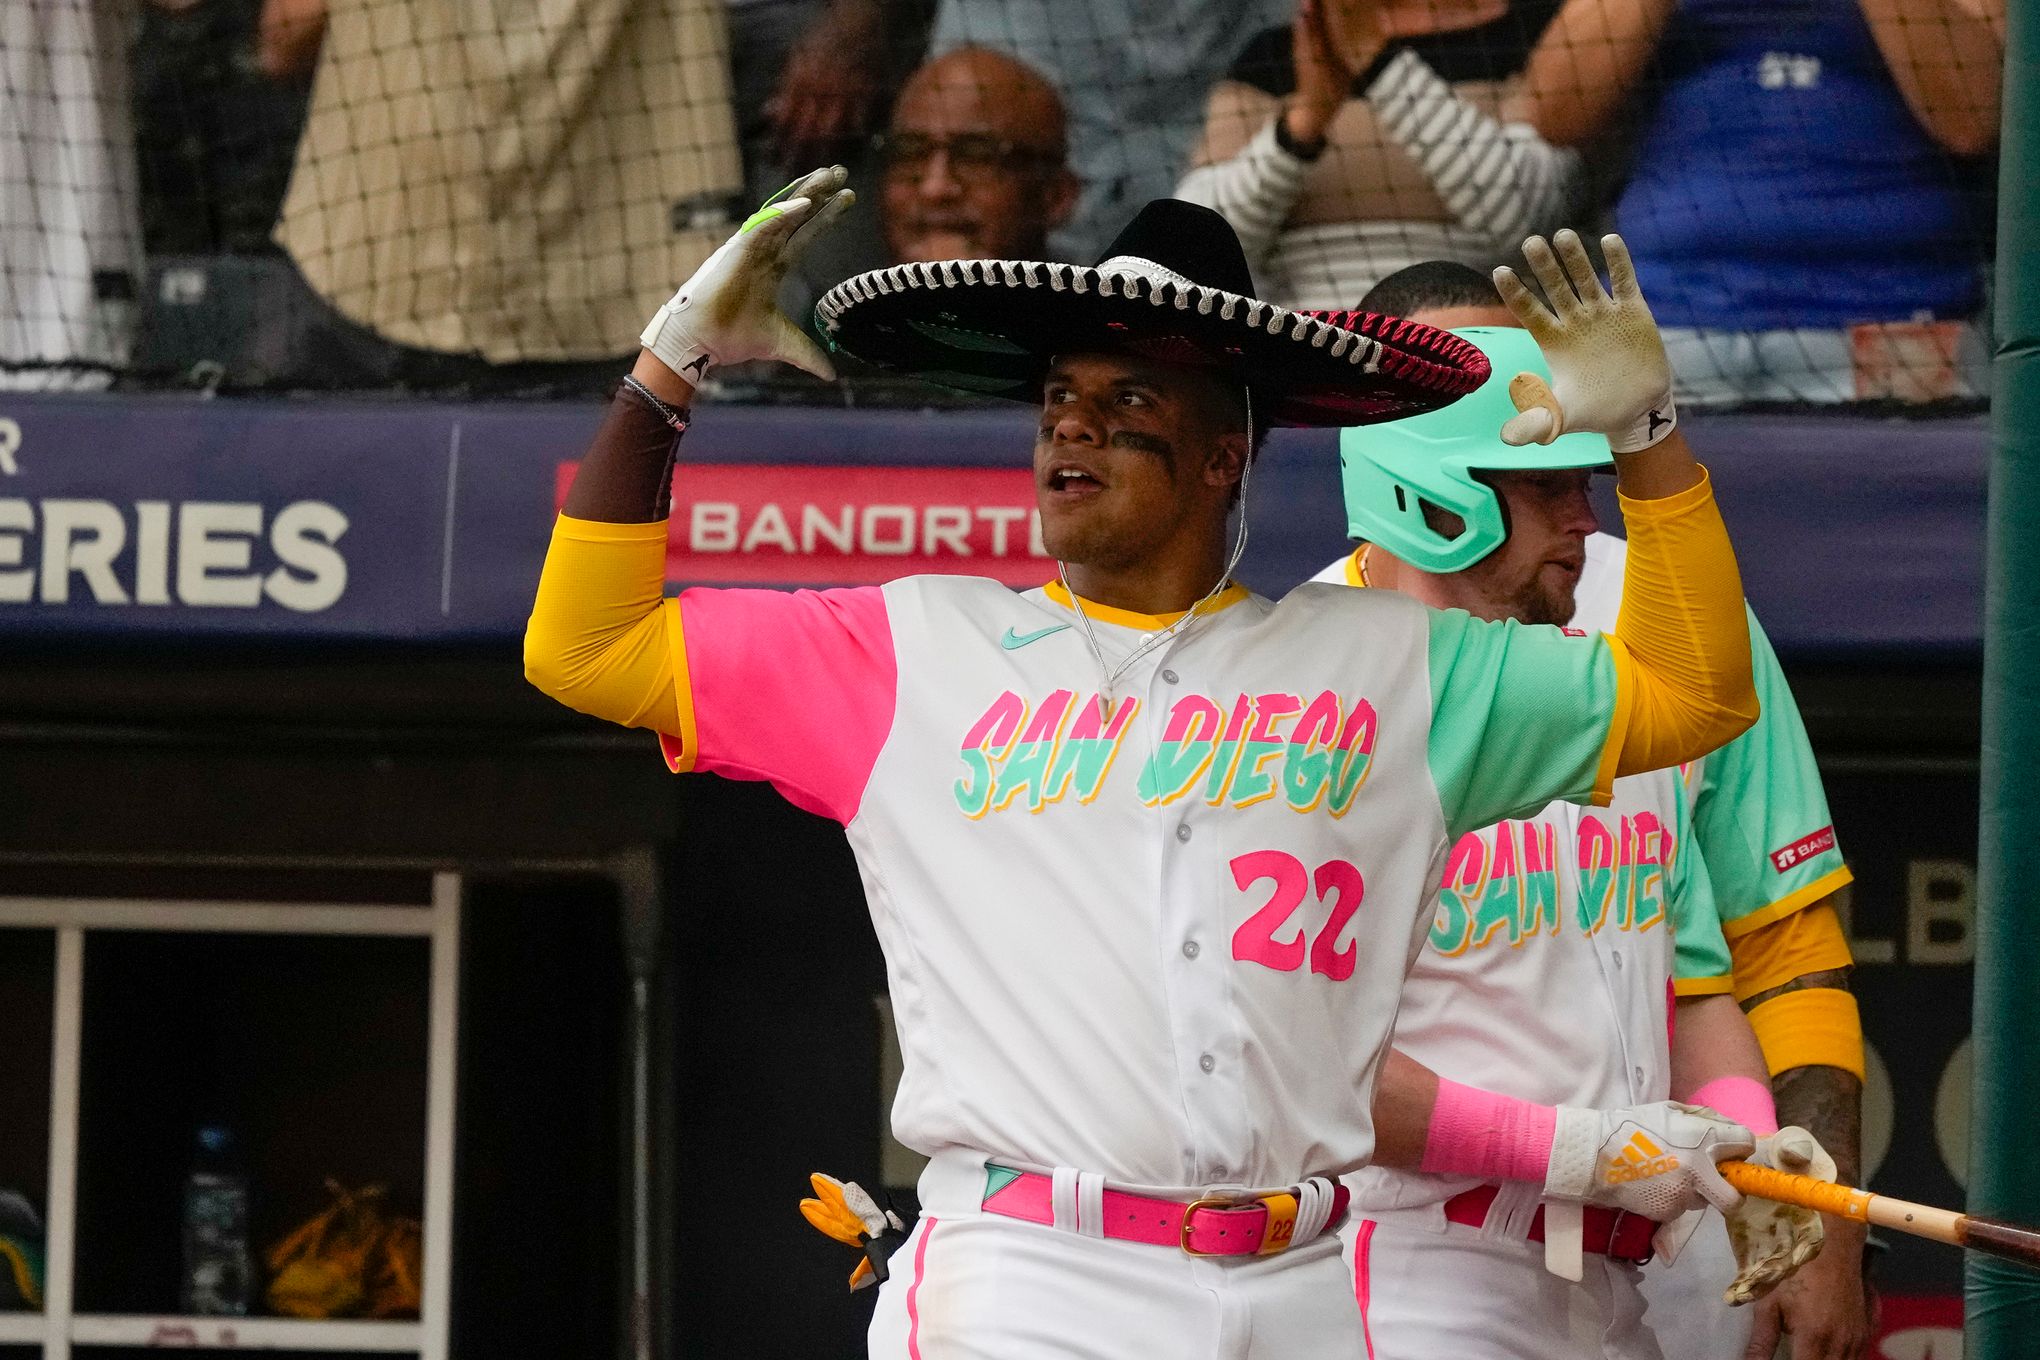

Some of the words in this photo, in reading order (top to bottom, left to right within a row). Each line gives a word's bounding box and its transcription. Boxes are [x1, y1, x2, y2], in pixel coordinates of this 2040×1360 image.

[953, 688, 1142, 821] SAN
[1136, 689, 1380, 820] DIEGO
[1229, 850, 1365, 982] 22
[1429, 820, 1560, 957] SAN
[1270, 1219, 1293, 1242] 22
[1606, 1155, 1680, 1184] adidas
